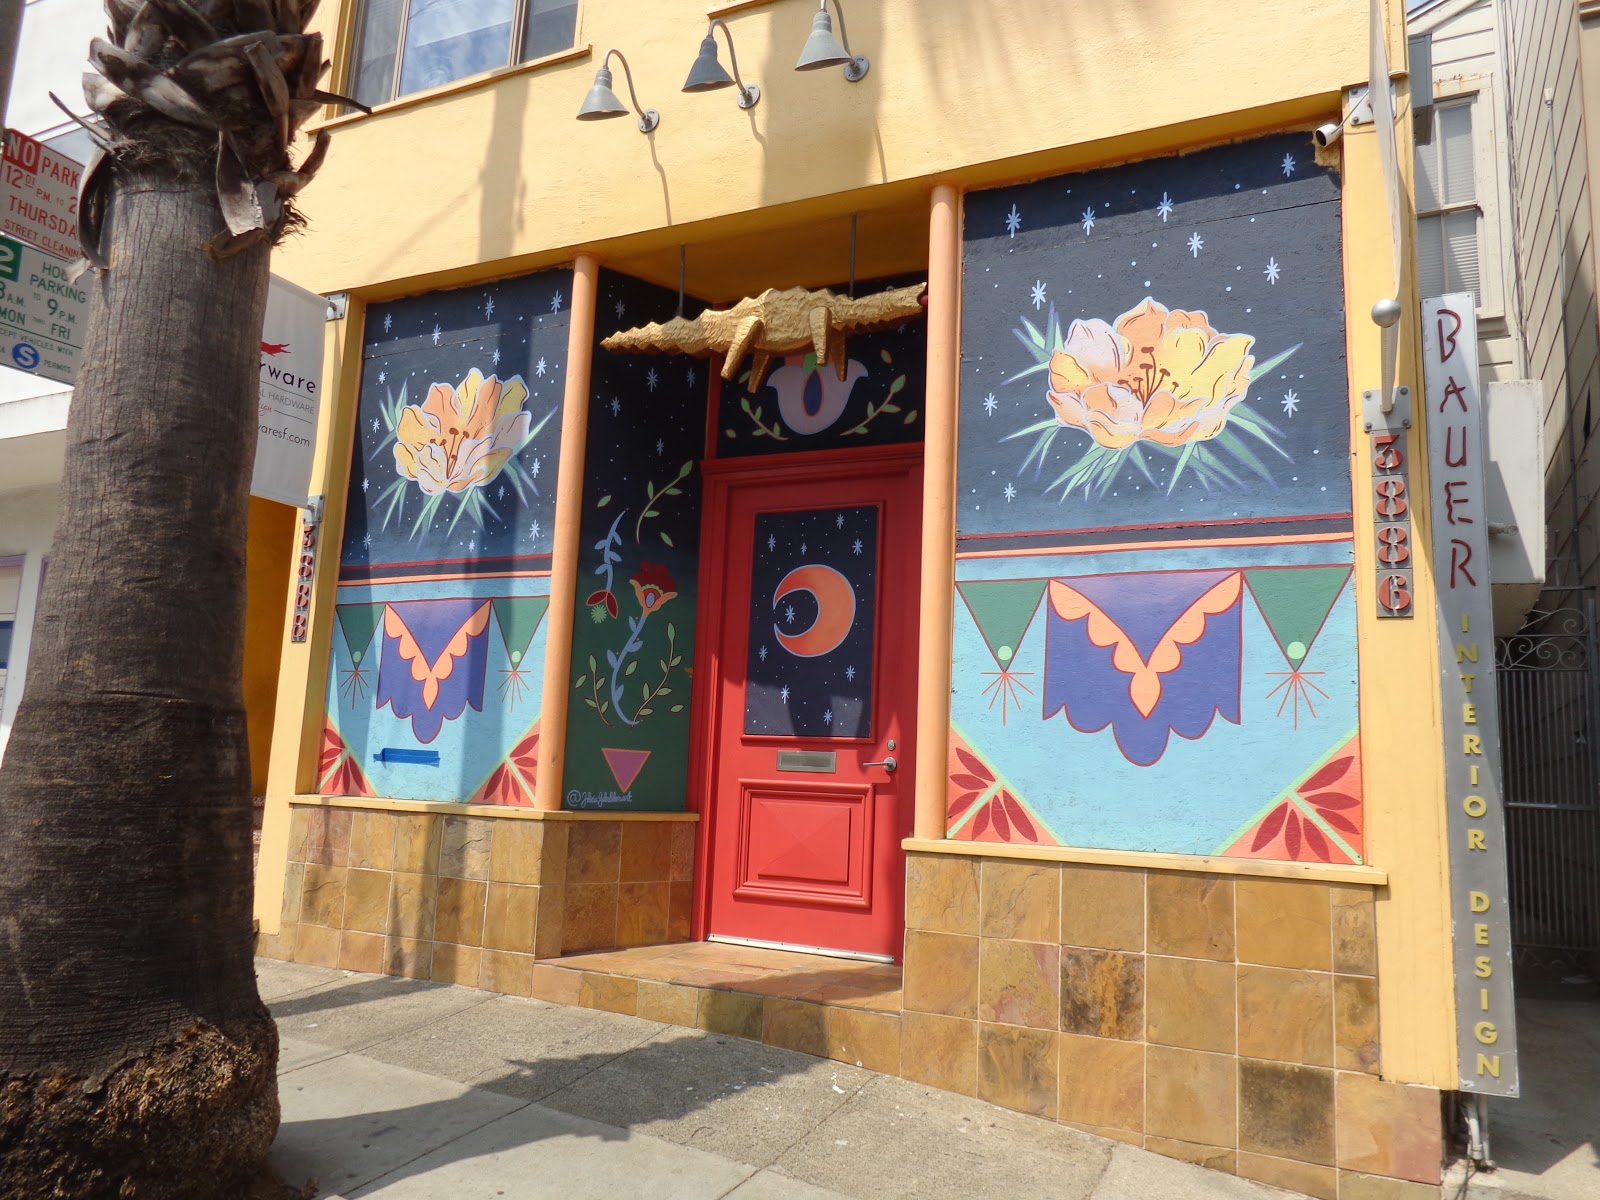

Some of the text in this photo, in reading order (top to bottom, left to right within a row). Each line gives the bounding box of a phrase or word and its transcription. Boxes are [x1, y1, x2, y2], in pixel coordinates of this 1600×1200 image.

[7, 132, 80, 190] NO PARK
[4, 218, 39, 241] STREET
[9, 194, 78, 240] THURSDA
[30, 273, 87, 304] PARKING
[0, 305, 26, 326] MON
[51, 322, 71, 341] FRI
[47, 298, 58, 316] 9
[16, 346, 36, 366] S
[43, 359, 72, 374] PERMITS
[20, 334, 55, 352] VEHICLES
[57, 345, 73, 357] WITH
[259, 361, 317, 394] rware
[268, 391, 316, 415] HARDWARE
[1436, 308, 1477, 589] BAUER
[1373, 433, 1412, 612] 3886
[1455, 613, 1501, 1079] INTERIOR DESIGN
